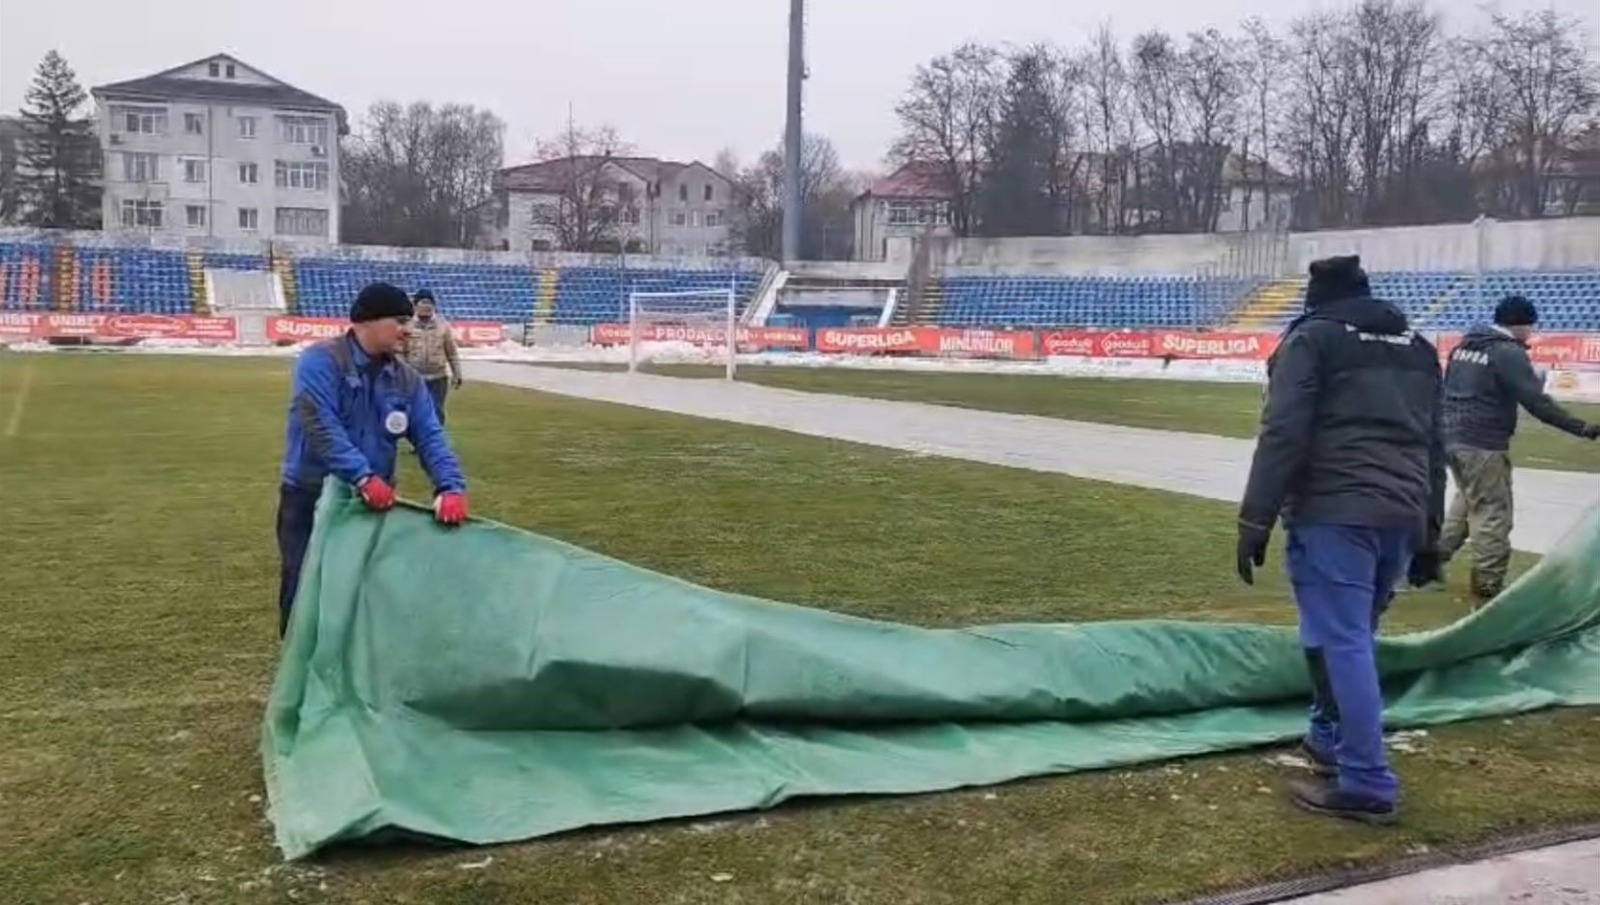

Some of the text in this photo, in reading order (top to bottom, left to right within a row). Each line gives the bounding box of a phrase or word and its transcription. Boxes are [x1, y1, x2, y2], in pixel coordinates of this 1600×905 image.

[48, 313, 106, 327] UNIBET
[656, 328, 748, 341] PRODALCM
[824, 330, 916, 348] SUPERLIGA
[1162, 334, 1259, 355] SUPERLIGA
